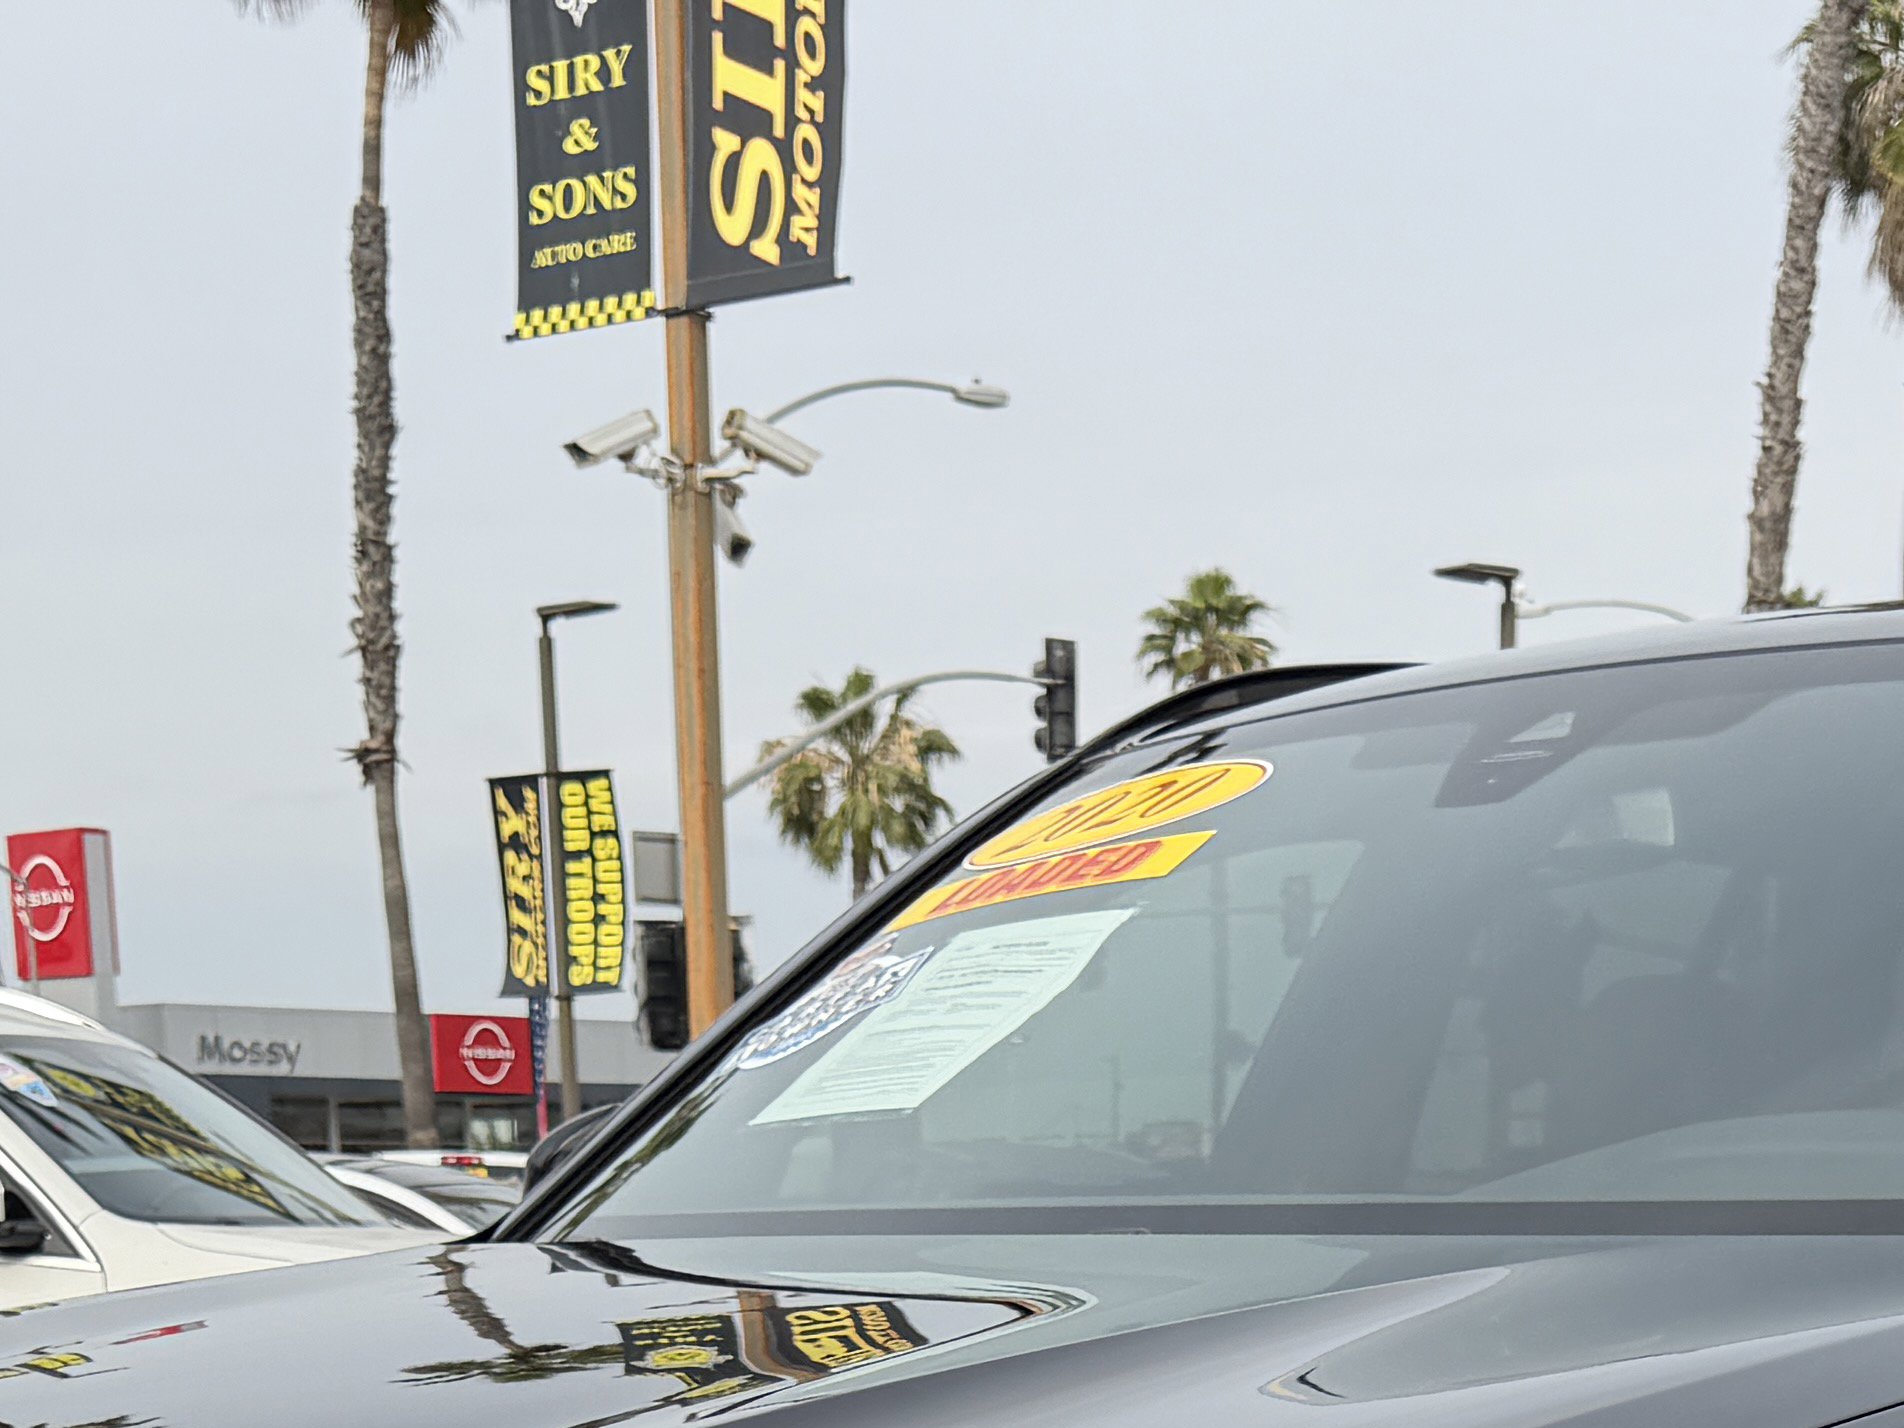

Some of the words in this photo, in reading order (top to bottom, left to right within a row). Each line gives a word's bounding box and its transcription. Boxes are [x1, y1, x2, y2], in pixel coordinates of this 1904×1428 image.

[525, 44, 633, 107] SIRY
[562, 118, 599, 155] &
[528, 165, 637, 226] SONS
[530, 242, 584, 269] AUTO
[584, 231, 637, 259] CARE
[559, 780, 591, 852] OUR
[586, 777, 616, 832] WE
[494, 786, 537, 987] SIRY
[592, 836, 625, 986] SUPPORT
[564, 853, 595, 986] TROOPS
[196, 1034, 301, 1074] Mossy
